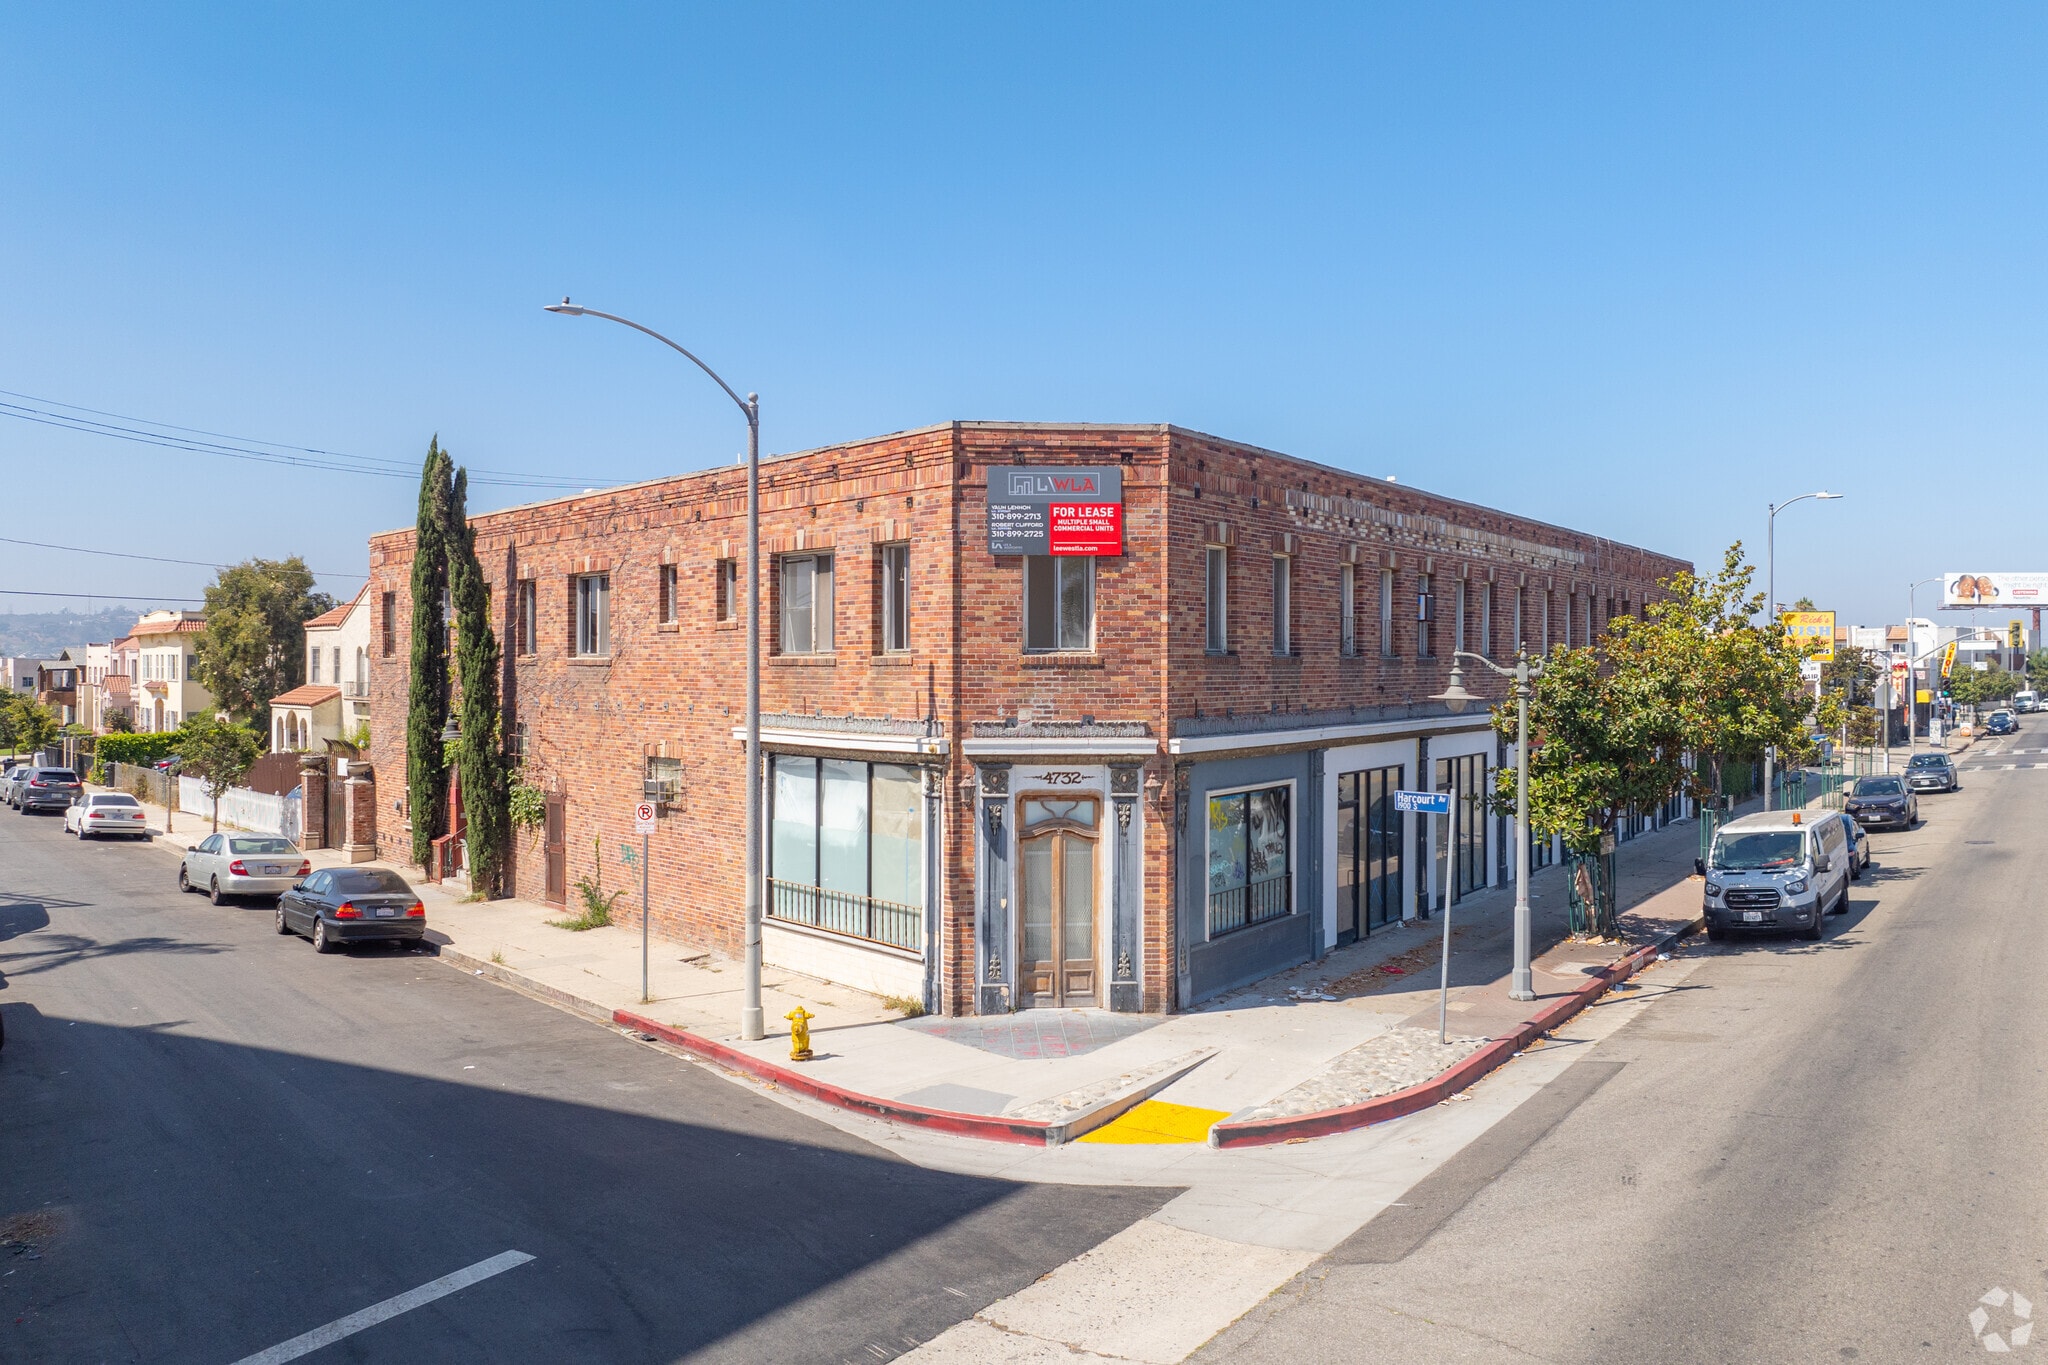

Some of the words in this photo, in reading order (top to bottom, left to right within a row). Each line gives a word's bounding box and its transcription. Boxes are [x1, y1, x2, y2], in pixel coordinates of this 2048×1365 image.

[1053, 507, 1075, 517] FOR
[1078, 507, 1114, 517] LEASE
[1800, 614, 1830, 624] Rick's
[1786, 625, 1831, 636] FISH
[1043, 771, 1081, 784] 4732
[1397, 792, 1435, 804] Harcourt
[1397, 802, 1411, 810] 1900
